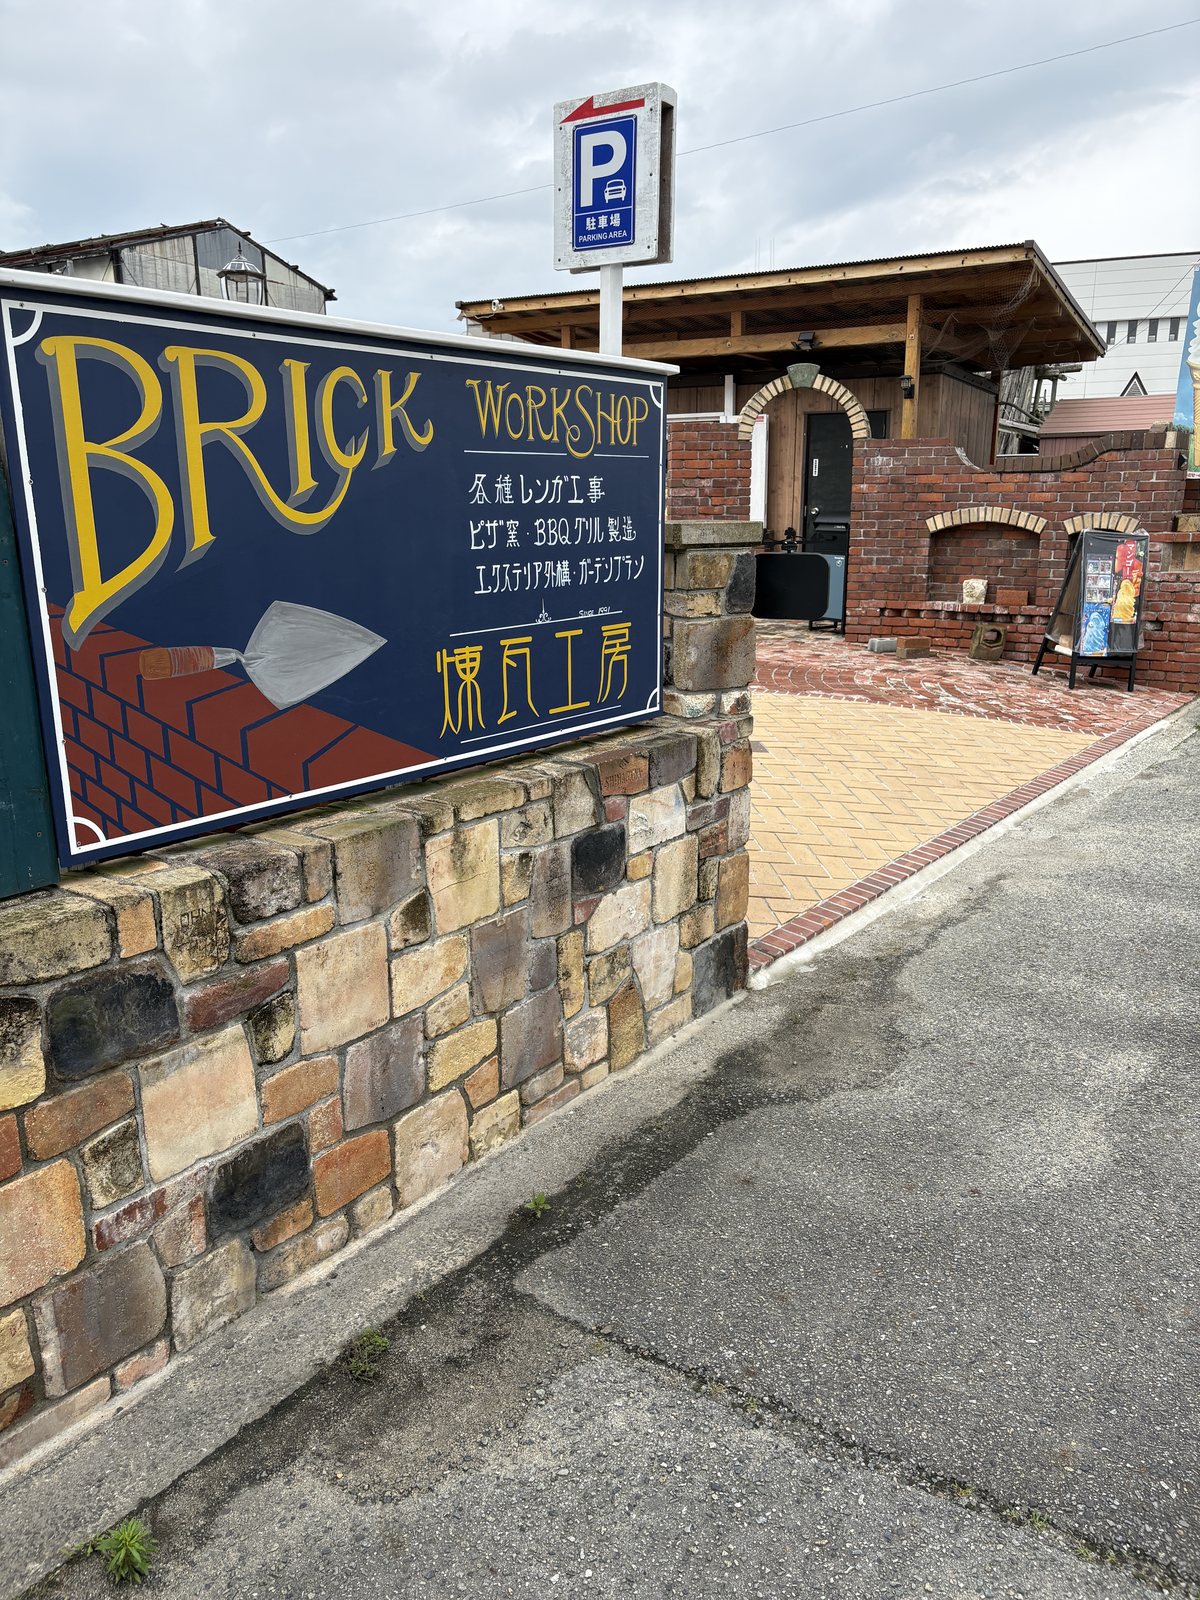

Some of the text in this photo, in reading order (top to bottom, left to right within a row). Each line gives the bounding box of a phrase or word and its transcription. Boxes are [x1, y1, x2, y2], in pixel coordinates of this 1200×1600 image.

[580, 130, 627, 208] P
[578, 230, 628, 243] PARKING AREA
[586, 213, 621, 231] 駐車場
[35, 335, 649, 645] BRICK WORKSHOP
[1125, 543, 1136, 575] マンゴー
